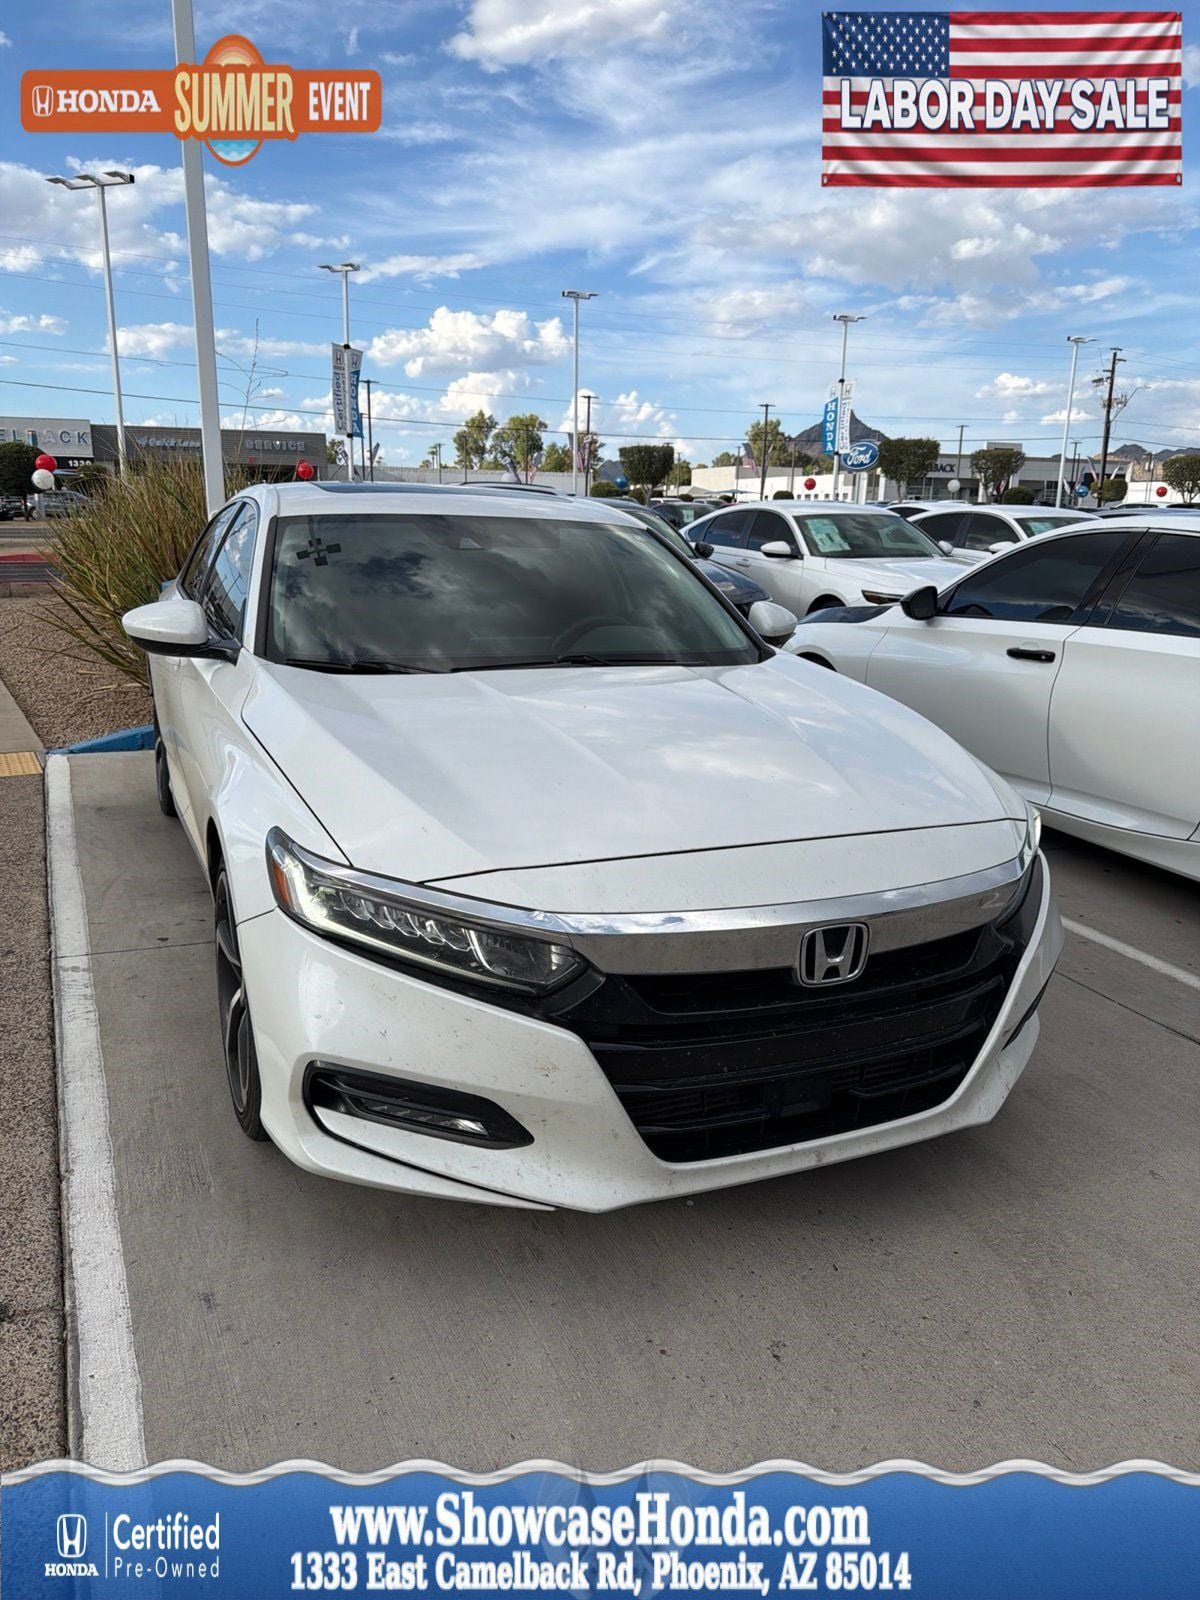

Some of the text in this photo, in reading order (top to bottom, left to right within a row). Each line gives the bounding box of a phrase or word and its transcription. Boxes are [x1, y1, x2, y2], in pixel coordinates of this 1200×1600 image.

[825, 401, 837, 452] HONDA
[245, 439, 305, 451] SERVICE
[846, 446, 873, 466] Ford
